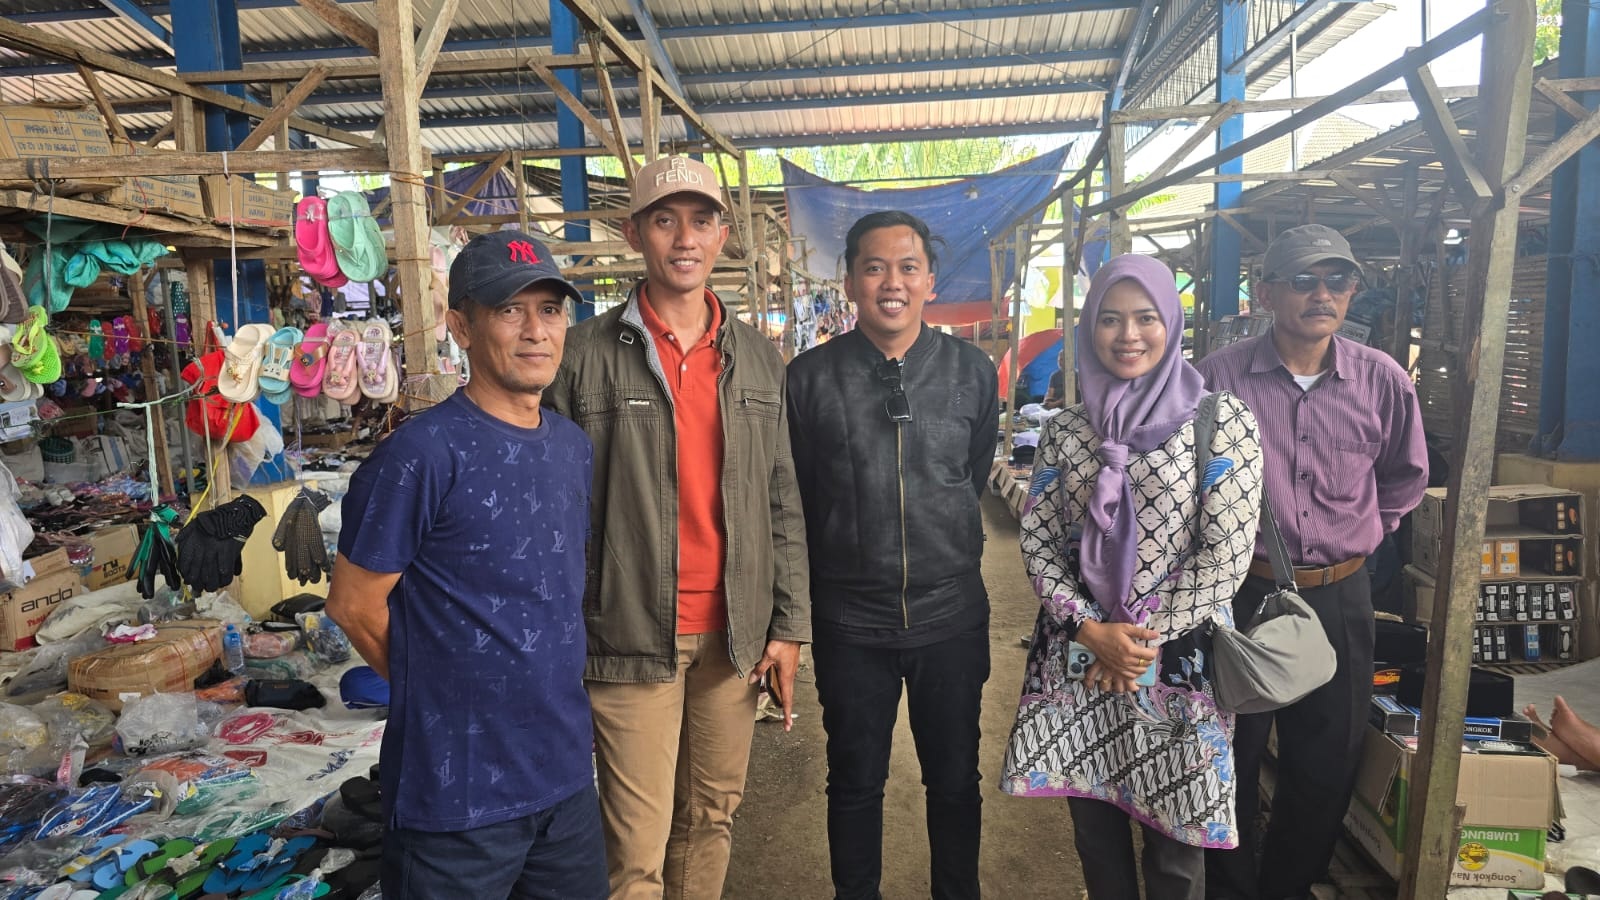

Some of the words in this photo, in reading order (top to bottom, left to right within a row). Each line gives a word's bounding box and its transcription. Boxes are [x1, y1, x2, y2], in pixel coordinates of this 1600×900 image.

[655, 168, 704, 187] FENDI
[21, 588, 73, 613] ando
[1463, 725, 1493, 736] ONGKOK
[1473, 872, 1517, 884] Songkok
